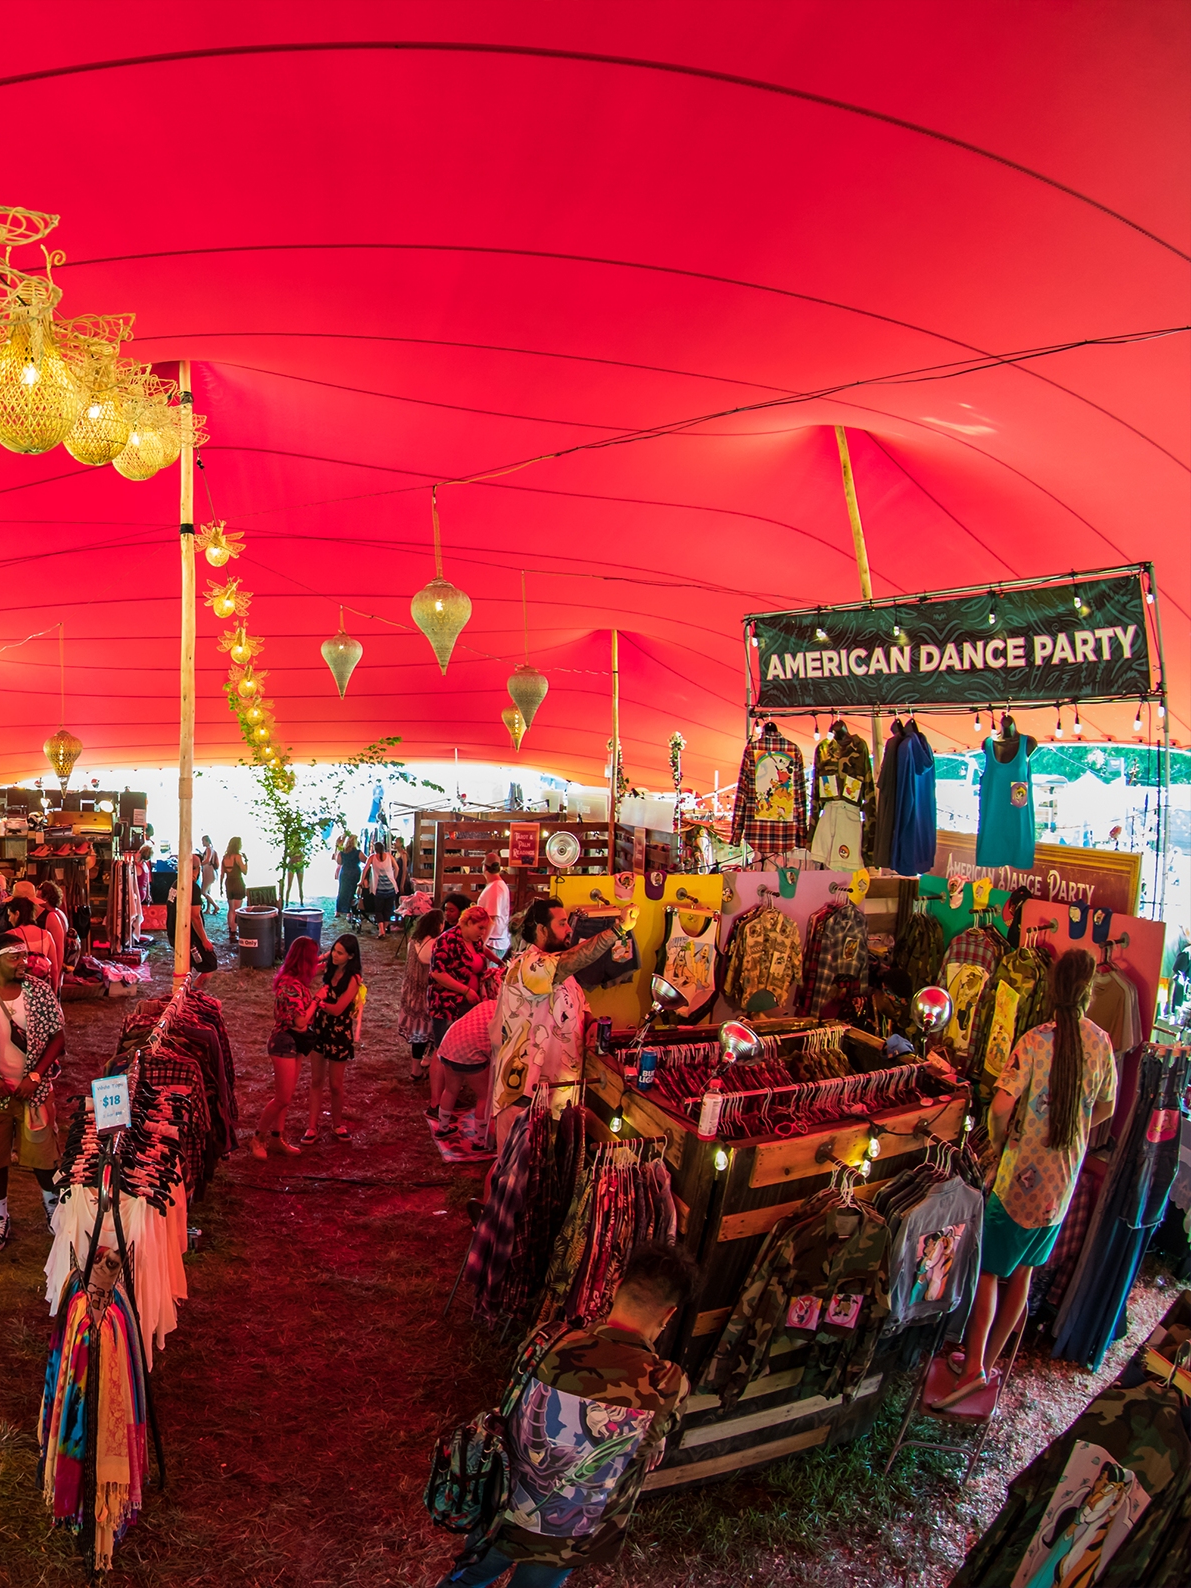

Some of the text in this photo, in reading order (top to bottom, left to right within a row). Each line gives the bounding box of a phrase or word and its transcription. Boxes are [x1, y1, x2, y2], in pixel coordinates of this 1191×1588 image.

[766, 624, 1138, 681] AMERICAN DANCE PARTY
[946, 852, 1096, 905] AMERICAN DANCE PARTY
[102, 1094, 121, 1109] $18
